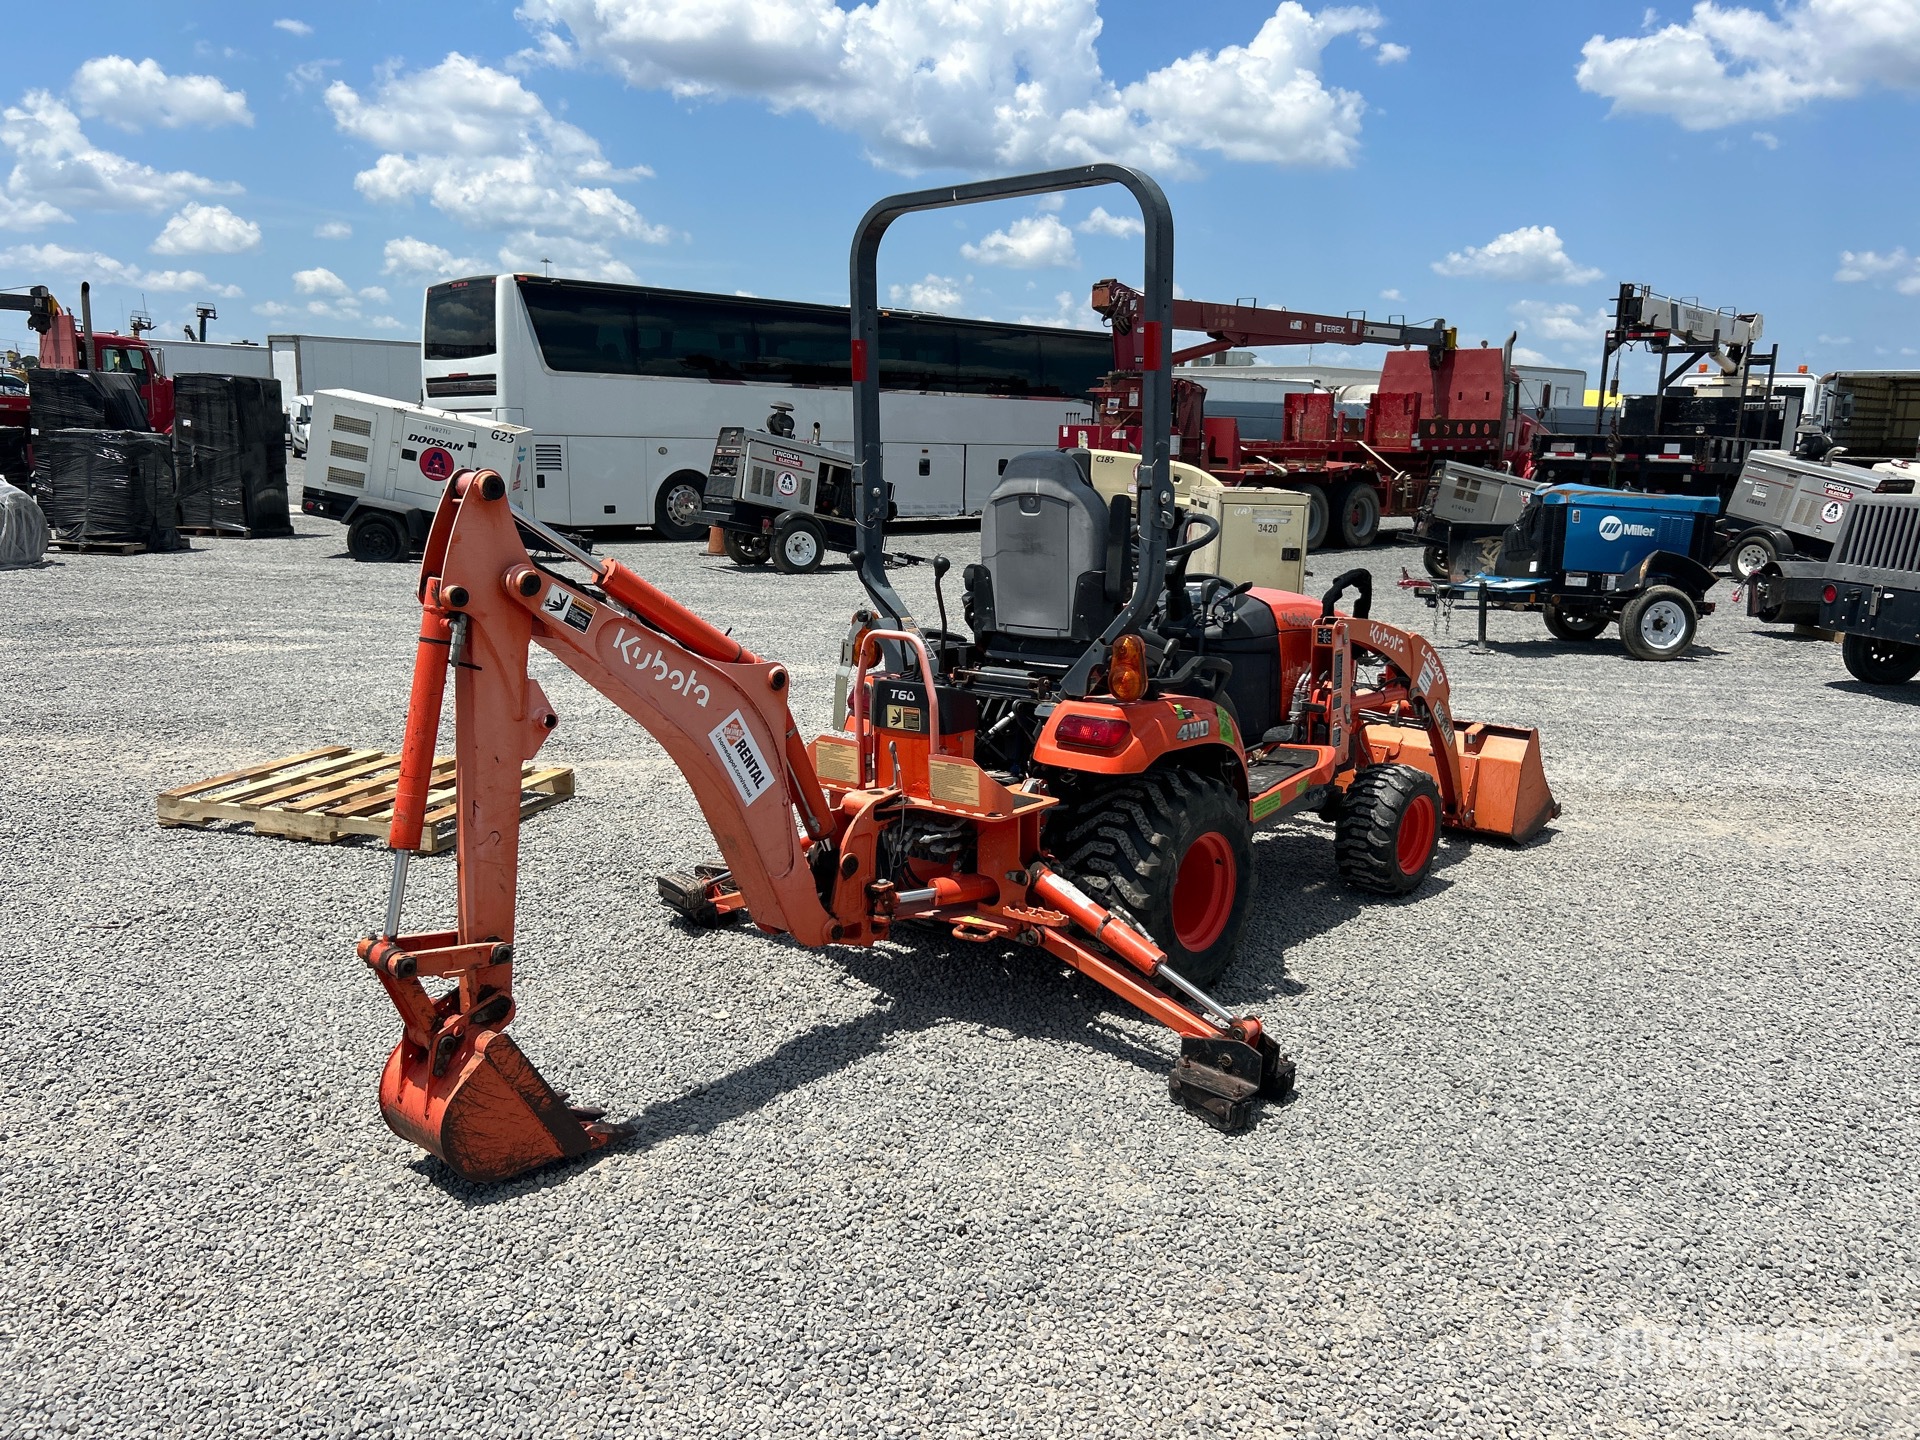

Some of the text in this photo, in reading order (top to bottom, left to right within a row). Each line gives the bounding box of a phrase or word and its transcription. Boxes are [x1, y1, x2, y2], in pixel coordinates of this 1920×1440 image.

[1322, 324, 1346, 334] TEREX
[407, 434, 465, 452] DOOSAN
[491, 429, 516, 444] G25
[773, 449, 799, 461] LINCOLN
[1095, 455, 1115, 464] C185
[1824, 482, 1851, 494] LINCOLN
[1828, 489, 1851, 499] ELECTRIC
[1257, 524, 1278, 534] 3420
[1623, 523, 1655, 537] Miller
[612, 627, 711, 708] Kubota
[1420, 644, 1445, 685] LA340
[890, 689, 916, 701] T60
[1176, 719, 1209, 741] 4WD
[717, 736, 753, 798] homedepot.com/rental
[734, 738, 766, 790] RENTAL
